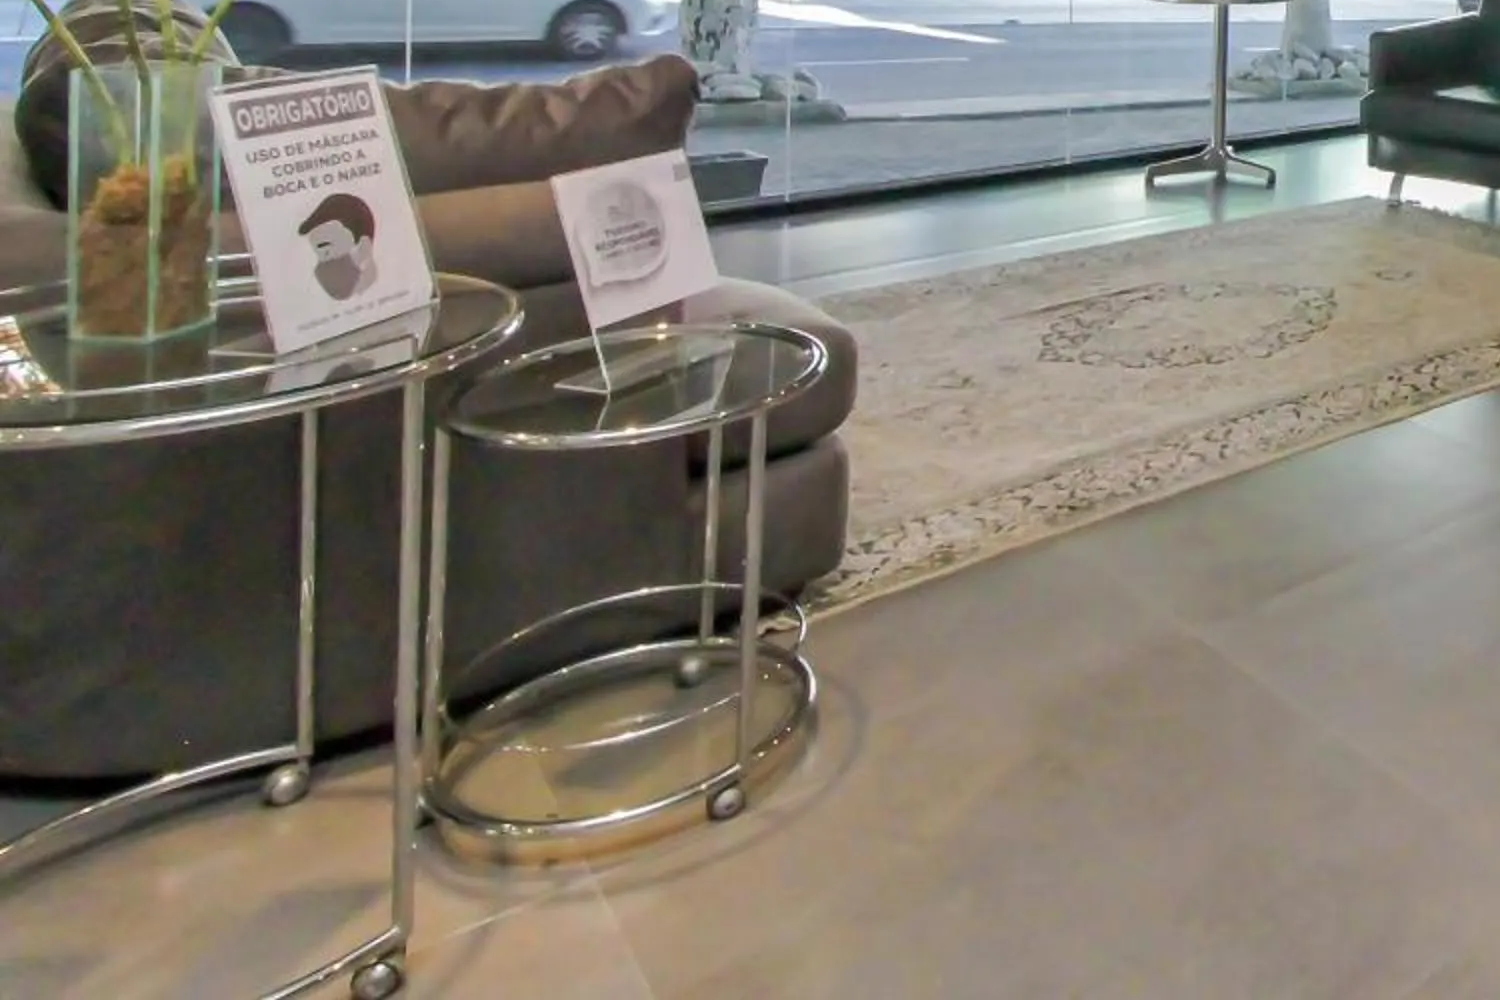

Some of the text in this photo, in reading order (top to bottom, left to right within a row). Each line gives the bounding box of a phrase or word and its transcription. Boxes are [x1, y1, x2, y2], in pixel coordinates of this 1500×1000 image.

[236, 87, 370, 132] OBRIGATÓRIO
[245, 147, 281, 164] USO
[284, 142, 304, 157] DE
[271, 149, 366, 177] COBRINDO A
[263, 162, 382, 198] BOCA E O NARIZ
